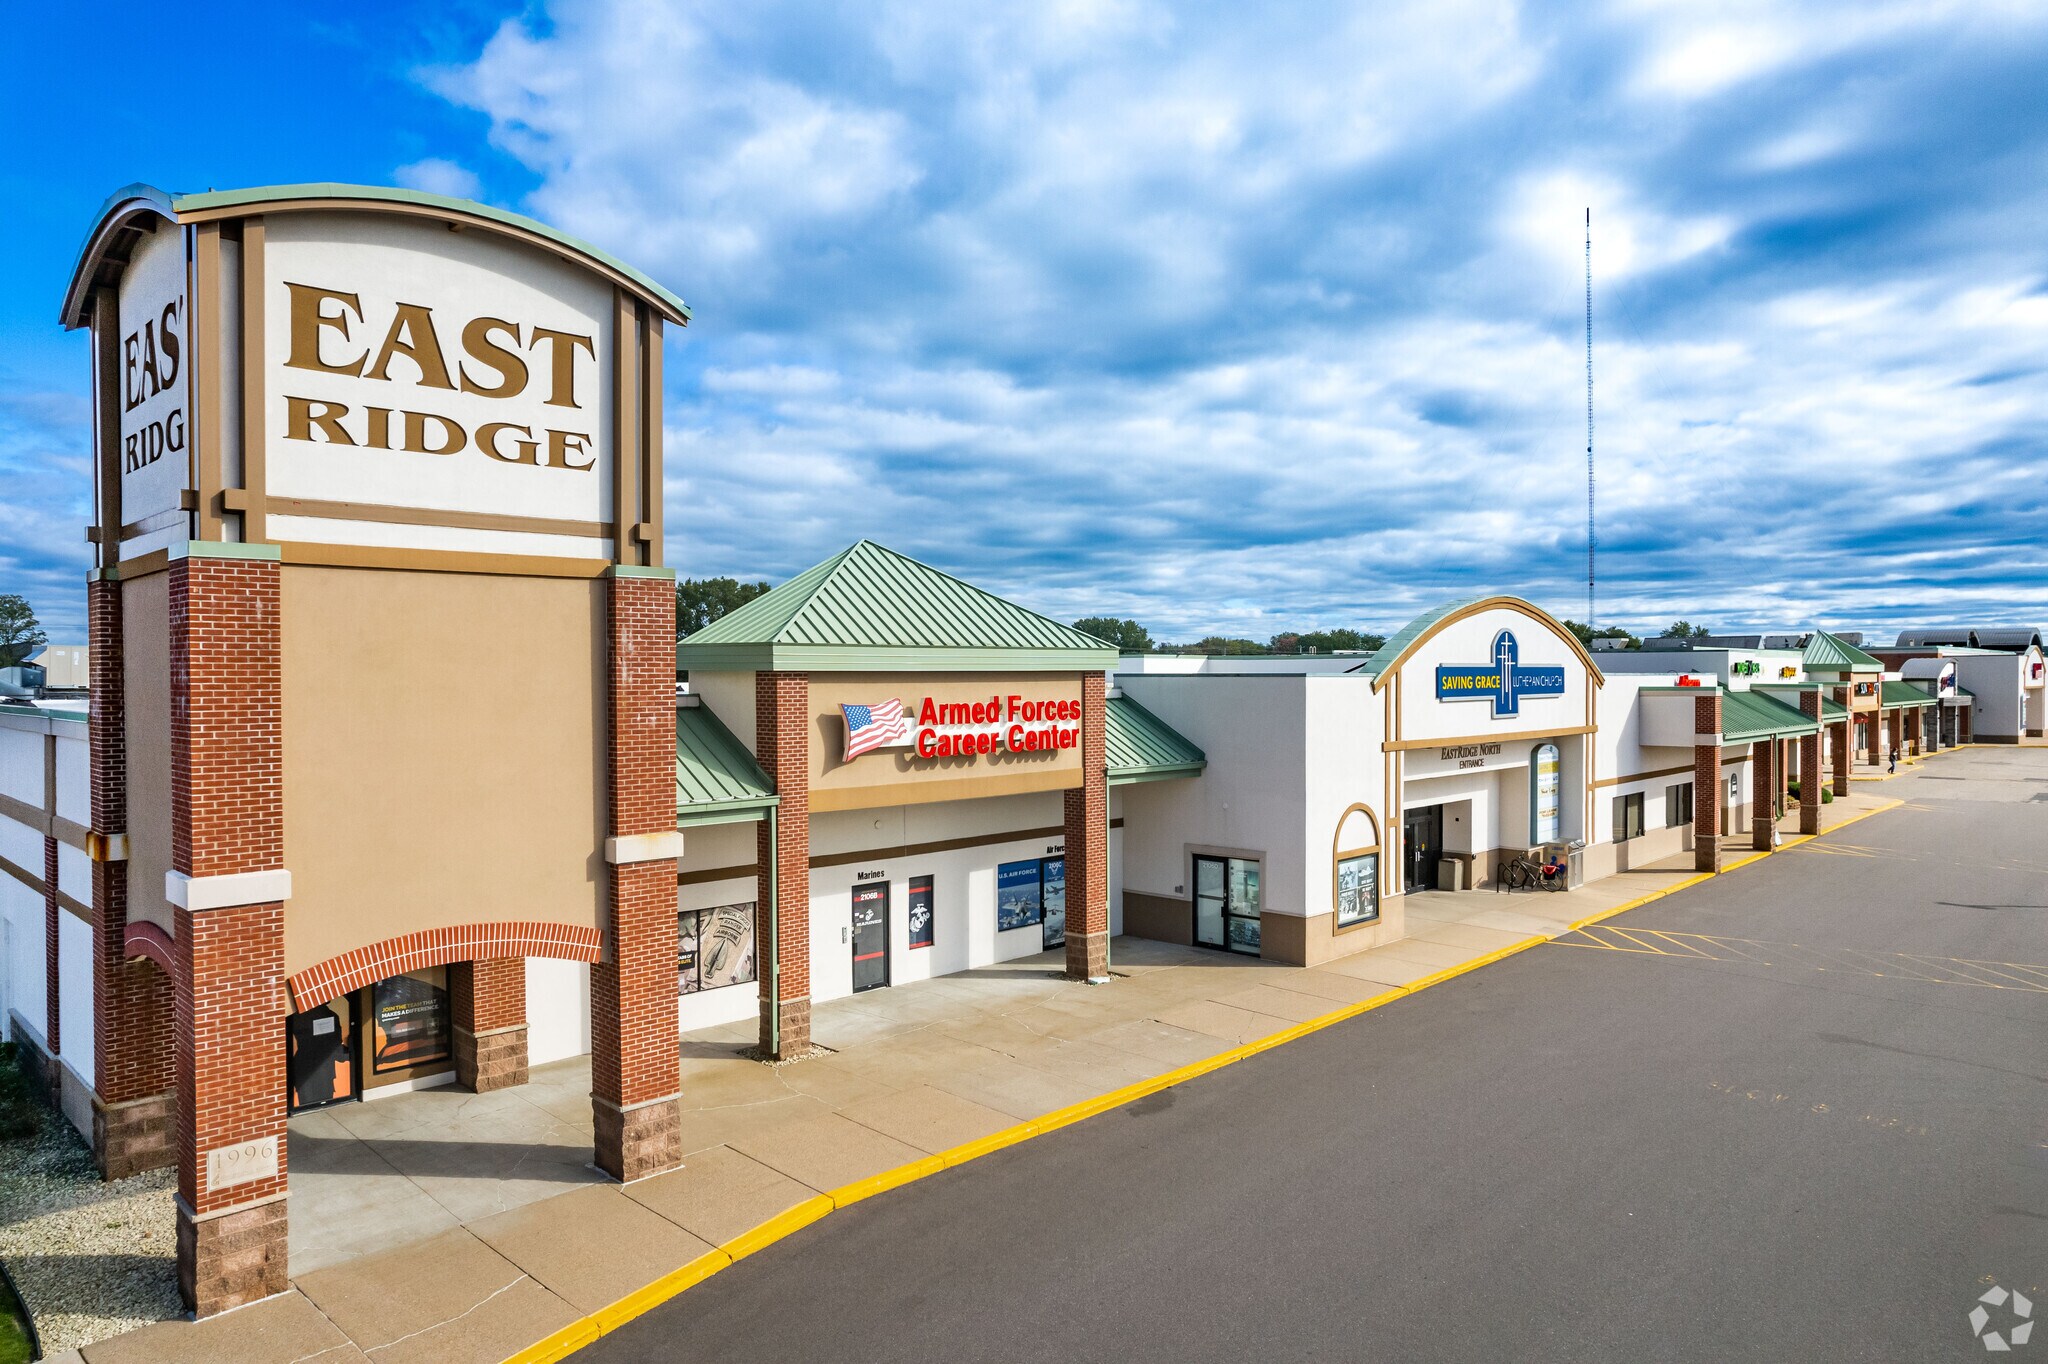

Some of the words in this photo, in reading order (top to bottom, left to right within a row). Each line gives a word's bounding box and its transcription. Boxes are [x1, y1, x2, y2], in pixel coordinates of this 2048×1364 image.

[124, 294, 184, 414] EAS
[282, 280, 597, 410] EAST
[125, 407, 185, 475] RIDG
[282, 395, 597, 472] RIDGE
[1441, 675, 1473, 691] SAVING
[1475, 675, 1501, 690] GRACE
[918, 695, 1000, 726] Armed
[1007, 695, 1081, 723] Forces
[918, 727, 1000, 759] Career
[1008, 724, 1080, 753] Center
[1459, 758, 1485, 769] ENTRANCE
[1054, 845, 1065, 853] Forc
[857, 870, 885, 881] Marines
[1018, 868, 1037, 876] FORCE
[716, 929, 739, 940] AIRBORNE
